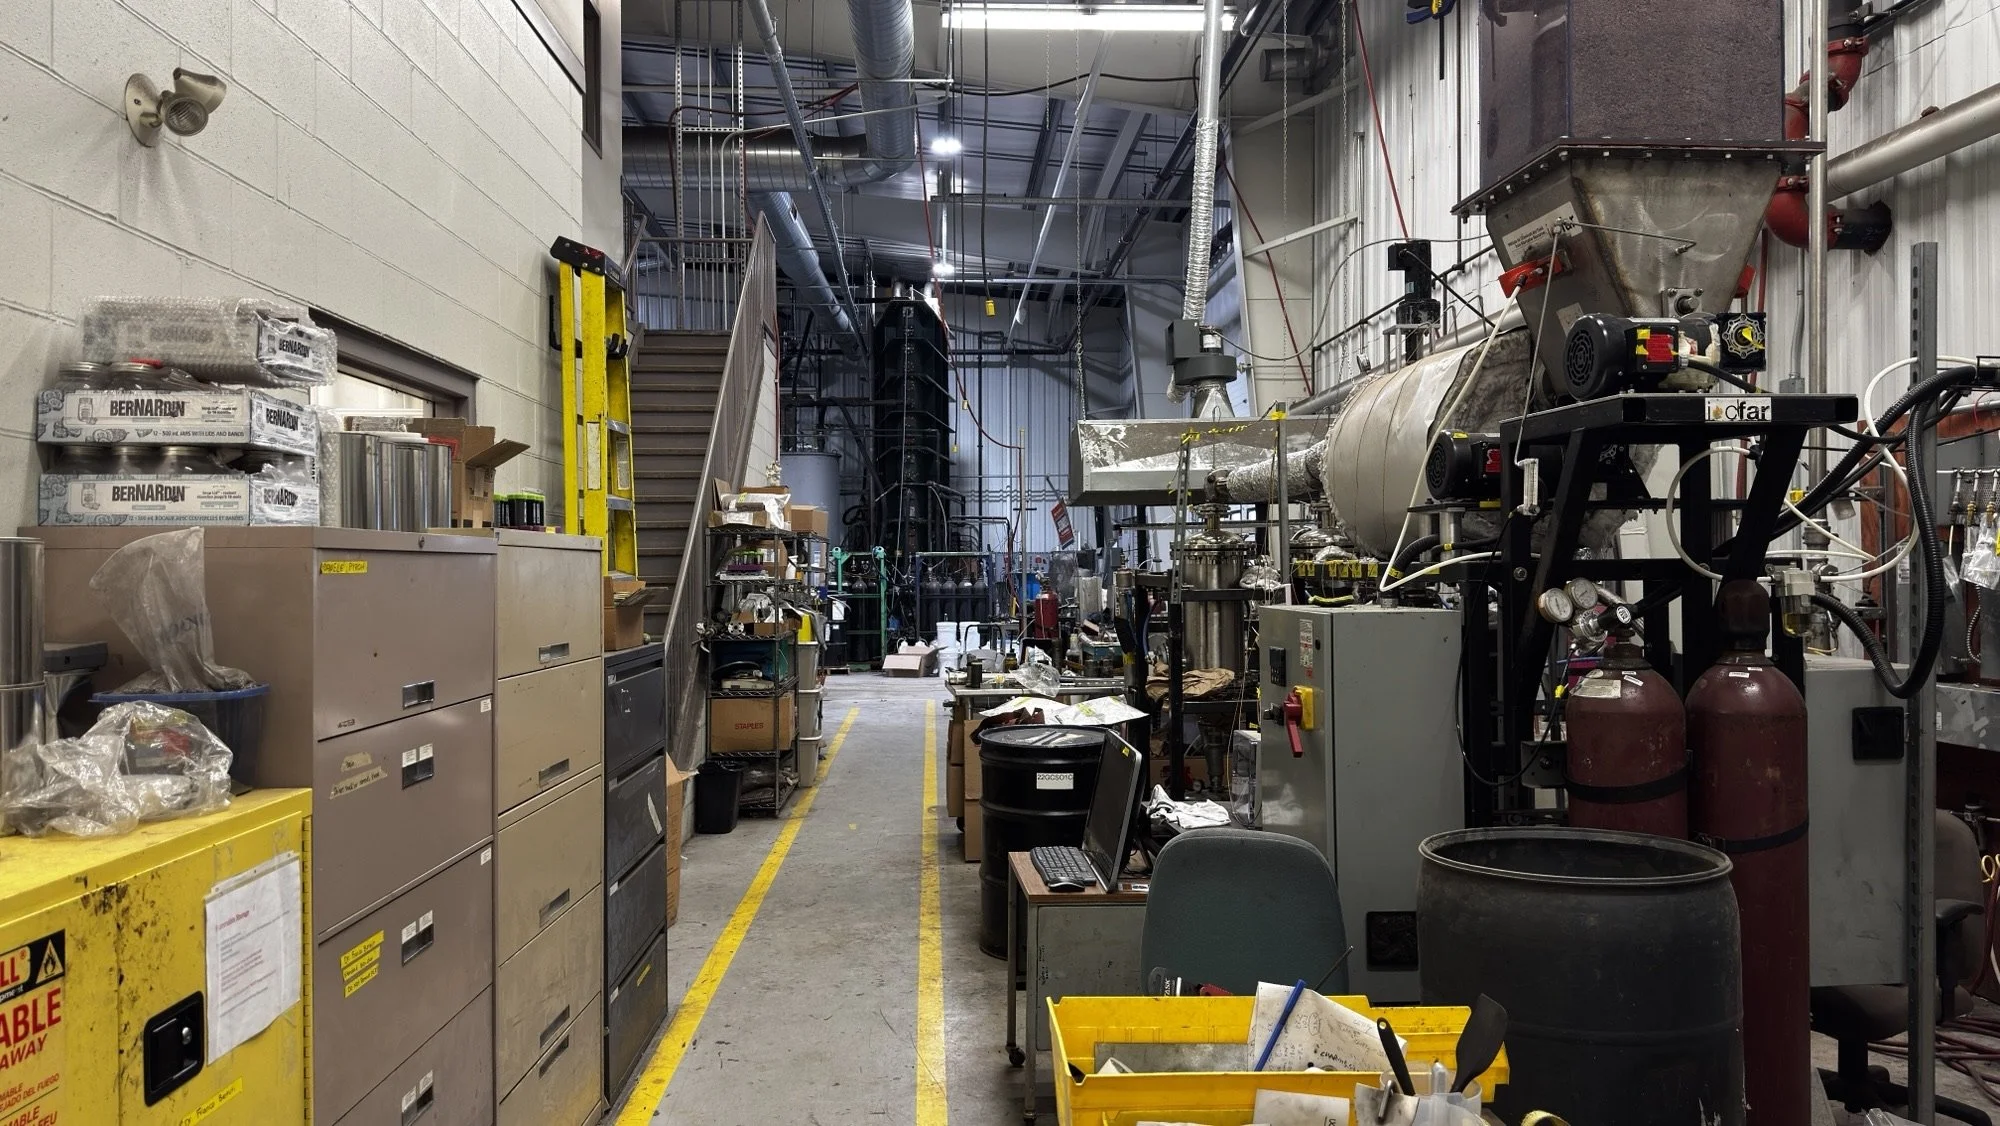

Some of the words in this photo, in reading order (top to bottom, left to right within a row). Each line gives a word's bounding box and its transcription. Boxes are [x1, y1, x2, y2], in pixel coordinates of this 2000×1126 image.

[110, 398, 185, 418] BERNARDIN
[266, 407, 299, 431] BERNARDIN
[112, 484, 185, 502] BERNARDIN
[735, 722, 764, 730] STAPLES
[0, 1033, 48, 1070] AWAY
[37, 1072, 60, 1092] FUEGO
